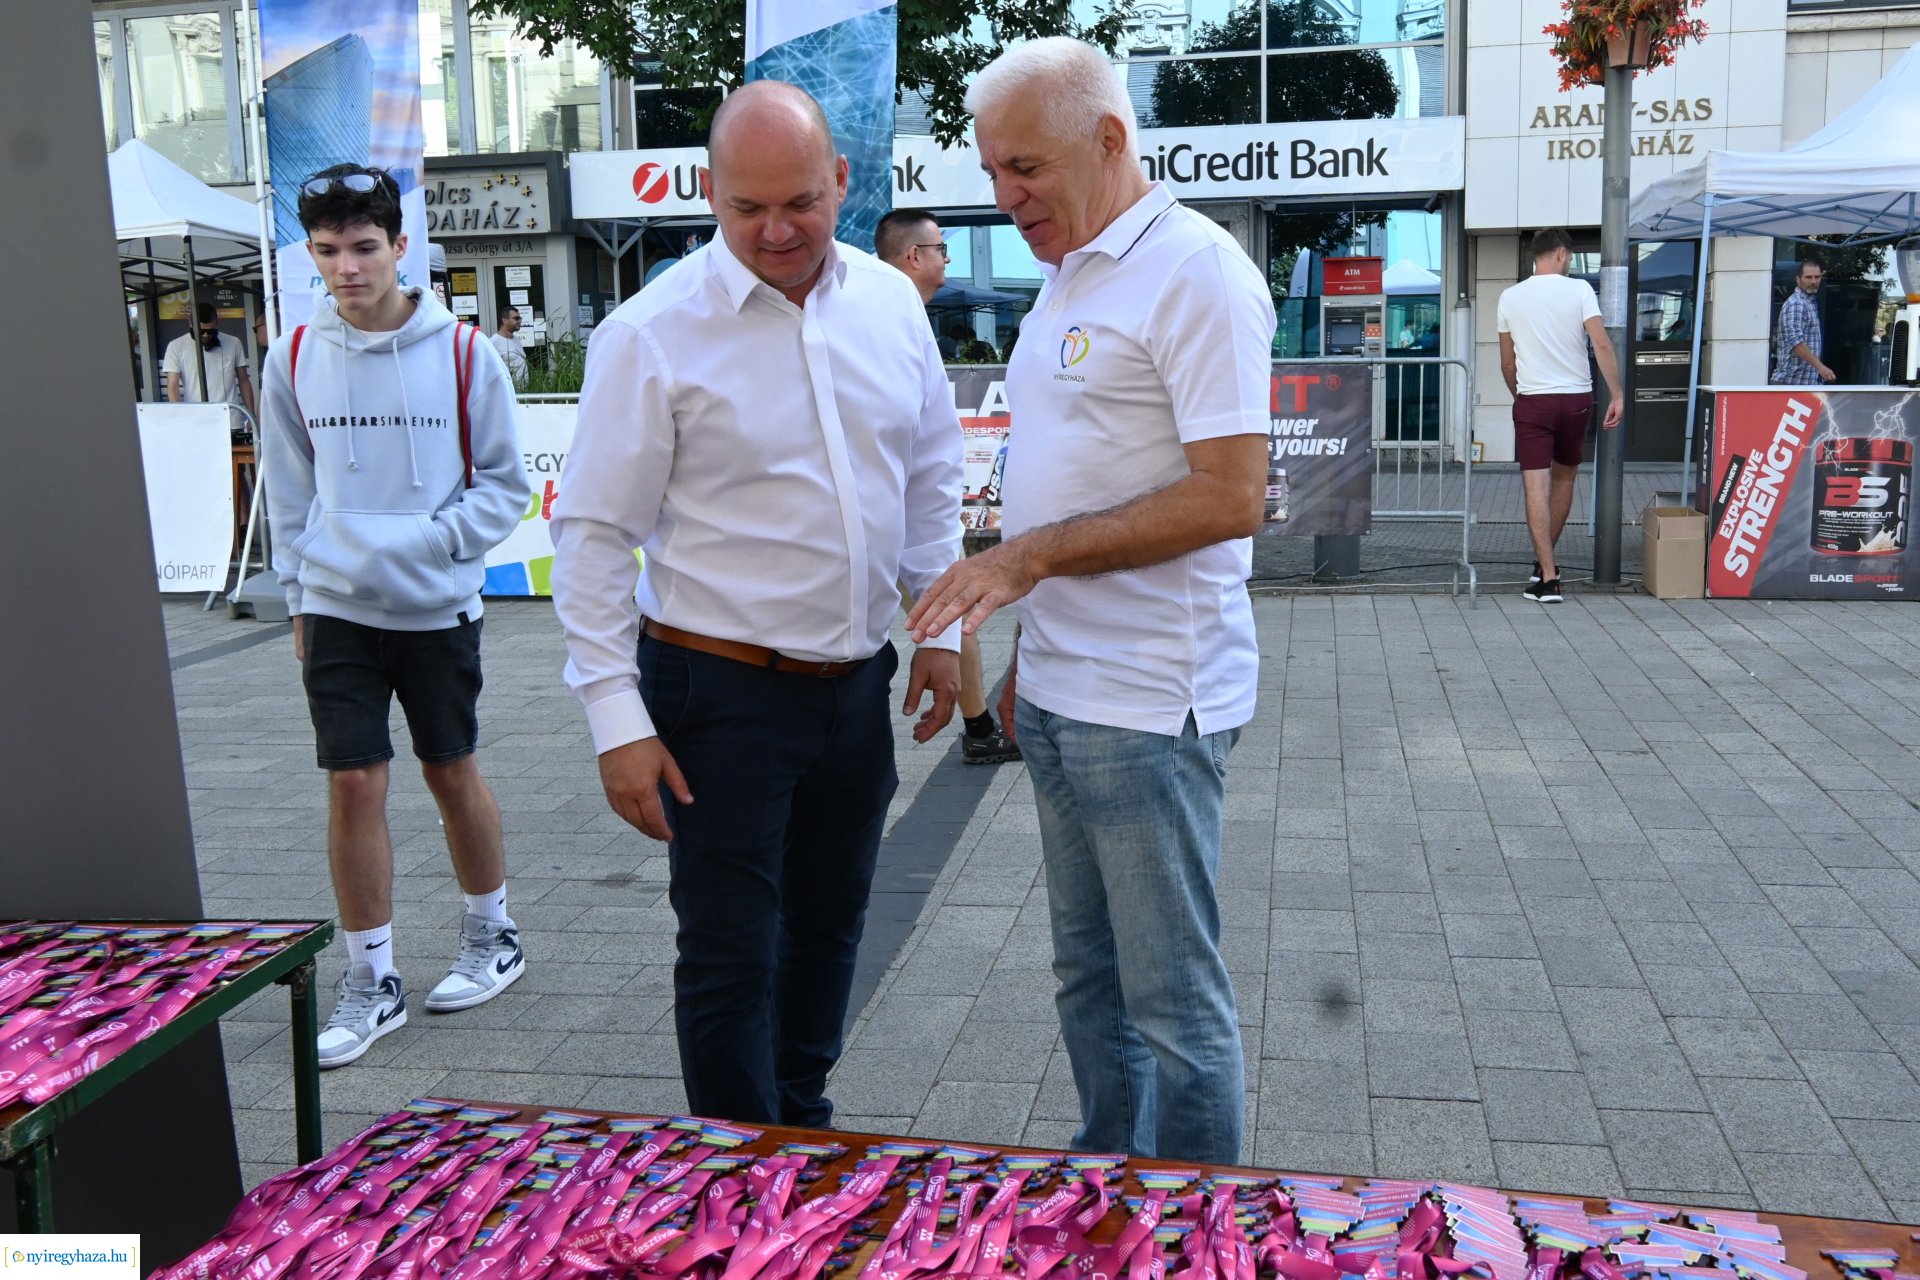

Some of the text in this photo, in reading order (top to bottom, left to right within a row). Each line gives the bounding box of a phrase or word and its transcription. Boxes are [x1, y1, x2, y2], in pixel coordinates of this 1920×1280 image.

[1530, 98, 1712, 129] ARA-SAS
[1547, 129, 1695, 160] IROHÁZ
[1140, 137, 1389, 184] niCredit Bank
[425, 182, 471, 205] olcs
[674, 164, 706, 200] U
[426, 200, 520, 232] DAHÁZ
[444, 240, 533, 256] ózsa György út 3/A
[1344, 268, 1361, 276] ATM
[948, 381, 1011, 418] LA
[962, 427, 1010, 435] DESPOR
[1270, 418, 1319, 436] wer
[523, 453, 569, 473] EGY
[1274, 438, 1348, 460] yours!
[1719, 462, 1738, 504] BRAND NEW
[1719, 449, 1764, 539] EXPLOSIVE
[1724, 398, 1812, 578] STRENGTH
[1818, 509, 1893, 519] PRE-WORKOUT
